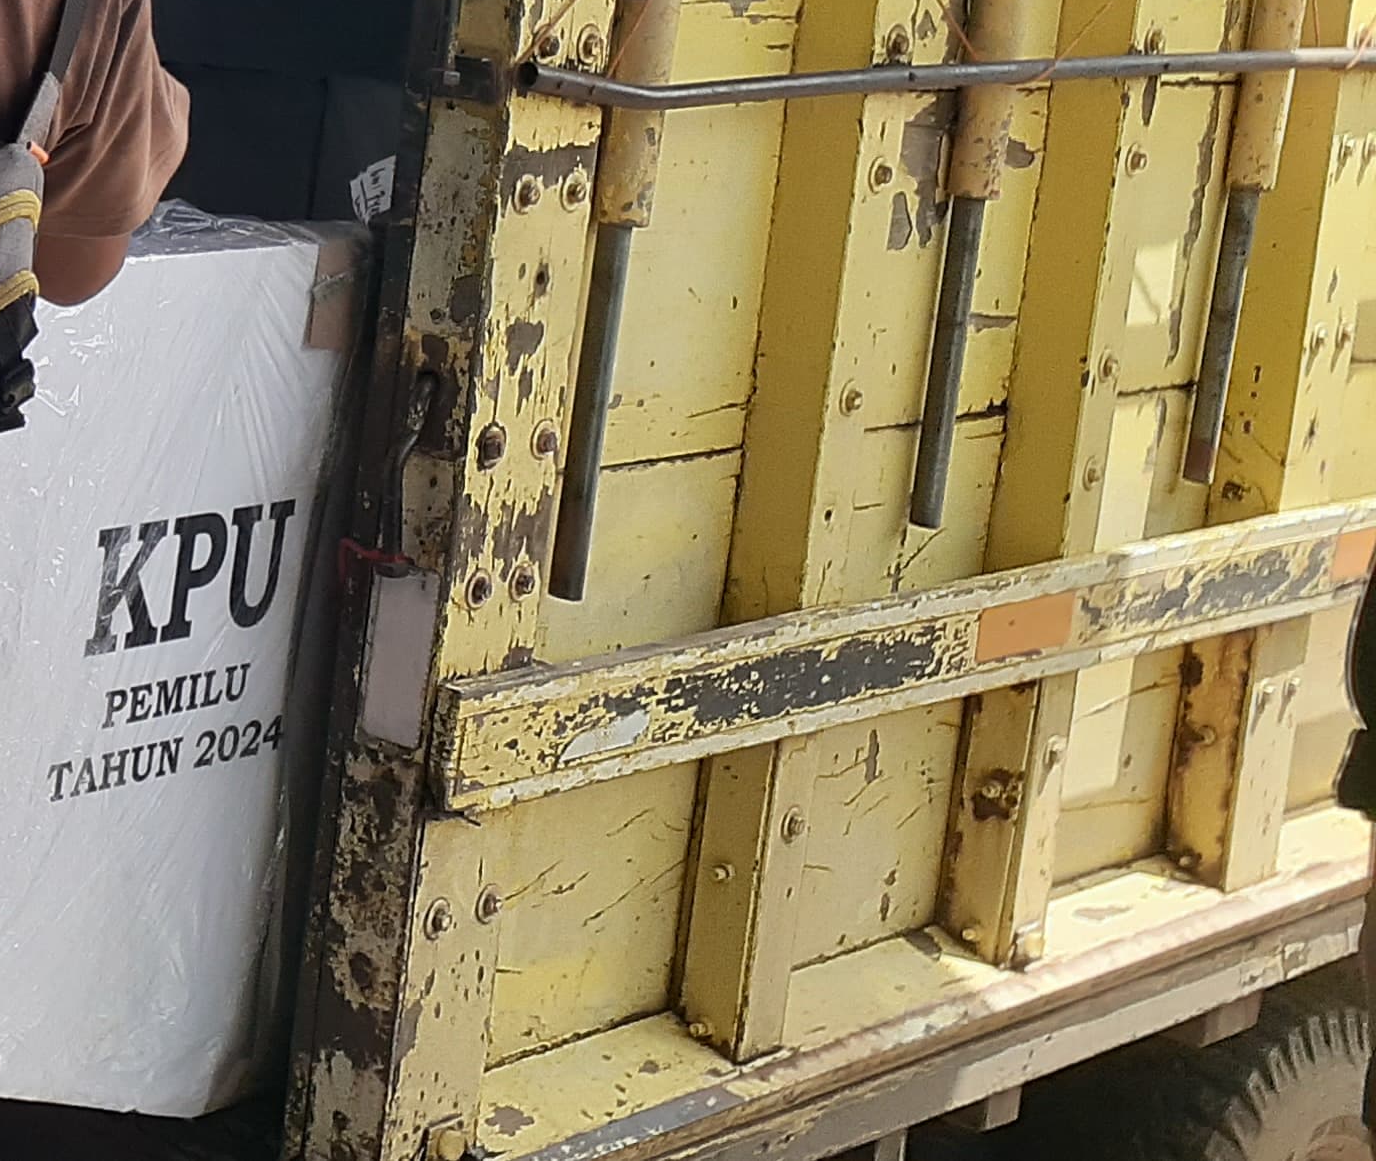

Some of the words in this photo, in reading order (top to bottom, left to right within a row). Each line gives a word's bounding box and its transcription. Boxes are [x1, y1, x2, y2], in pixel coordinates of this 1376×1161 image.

[83, 498, 297, 657] KPU
[100, 663, 251, 729] PEMILU
[47, 736, 185, 802] TAHUN
[192, 714, 285, 769] 2024
